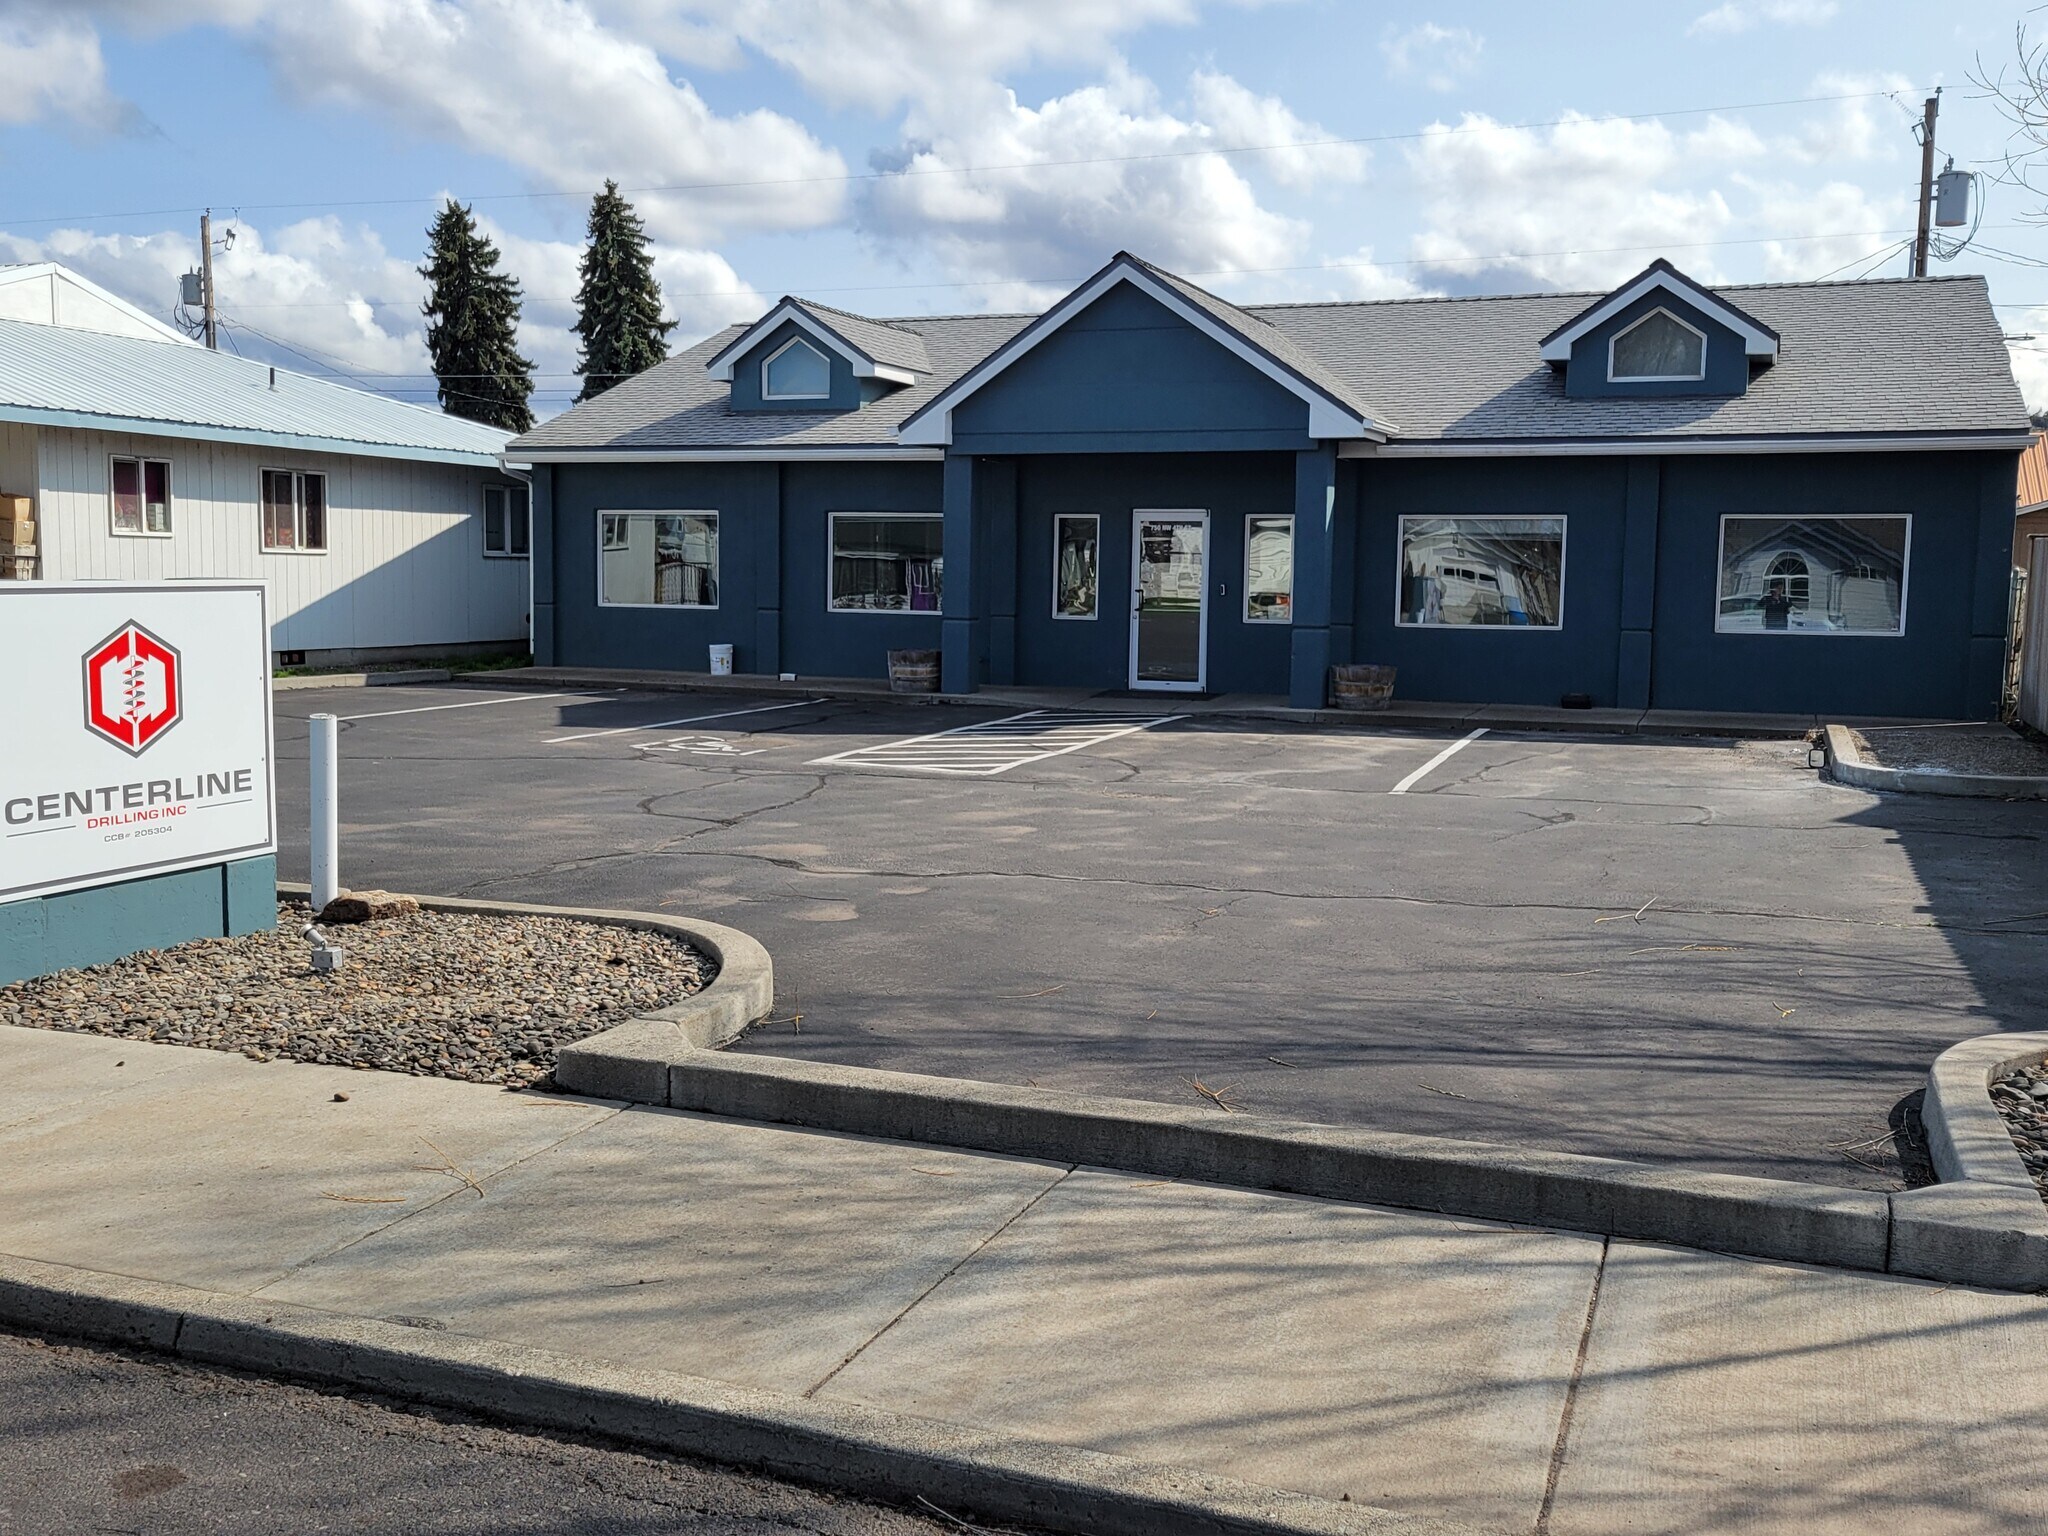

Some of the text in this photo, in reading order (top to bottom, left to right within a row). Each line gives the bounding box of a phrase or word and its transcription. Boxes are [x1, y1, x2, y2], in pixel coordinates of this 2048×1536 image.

[4, 768, 253, 825] CENTERLINE
[87, 805, 187, 829] DRILLING INC
[104, 825, 173, 843] CCB# 205304
